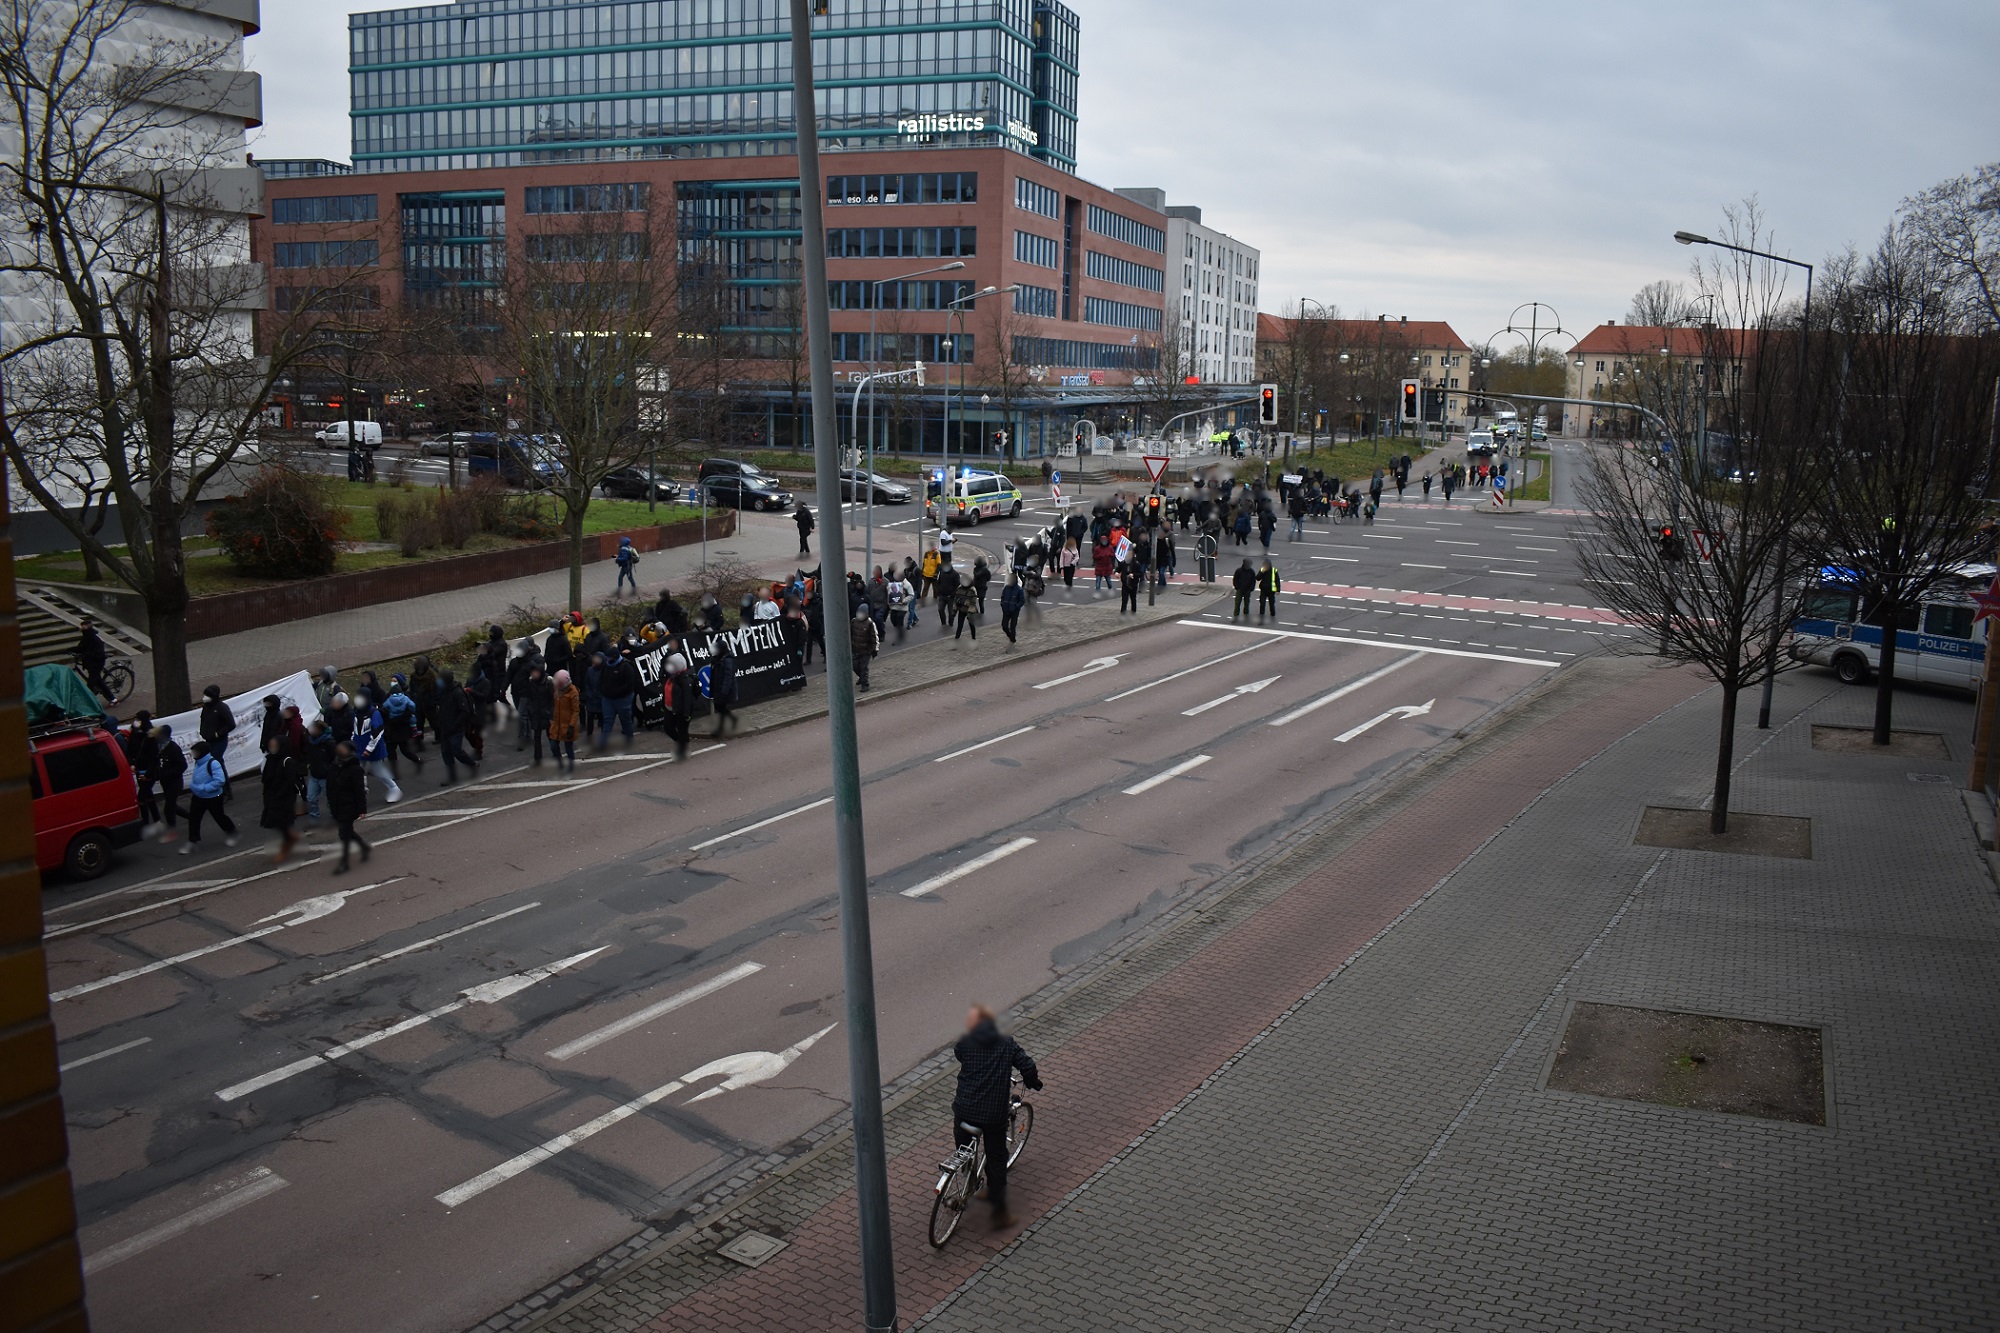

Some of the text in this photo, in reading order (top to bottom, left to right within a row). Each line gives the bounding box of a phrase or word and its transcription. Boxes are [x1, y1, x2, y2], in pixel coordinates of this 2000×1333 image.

[897, 113, 985, 134] railistics
[1007, 119, 1038, 146] railistics
[1919, 638, 1959, 652] POLIZEI
